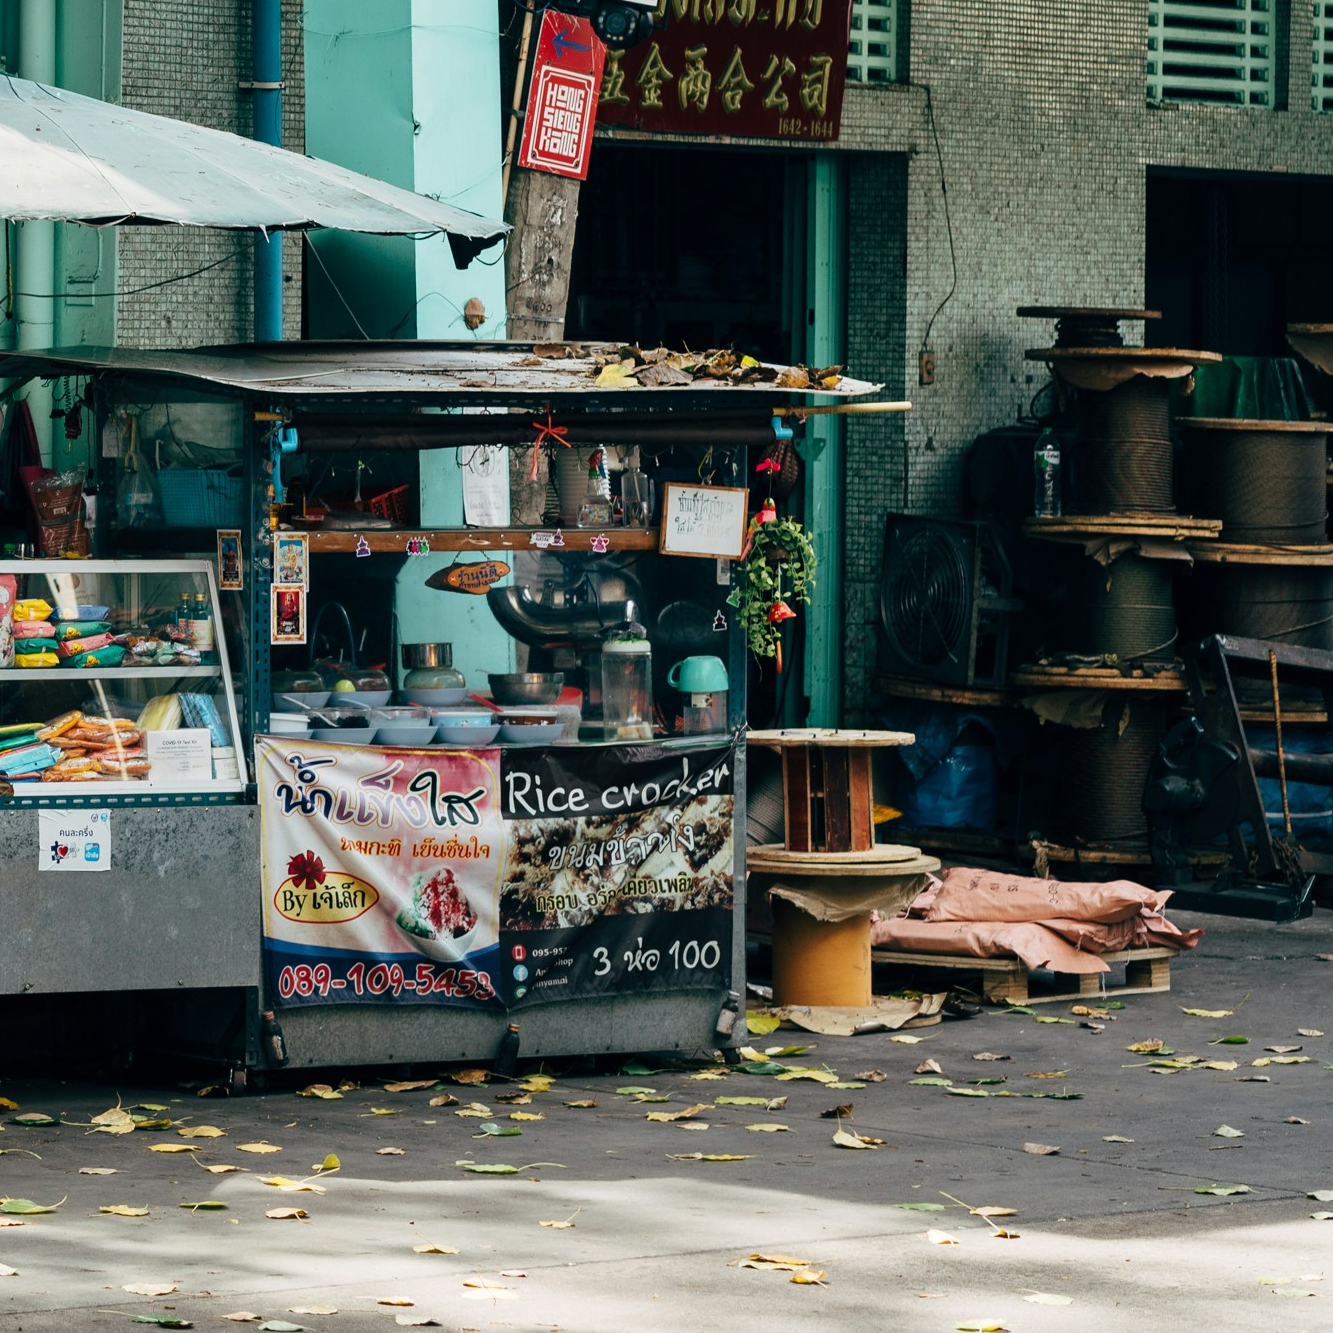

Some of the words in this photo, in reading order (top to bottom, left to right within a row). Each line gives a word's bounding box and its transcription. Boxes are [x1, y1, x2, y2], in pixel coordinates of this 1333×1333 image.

[545, 82, 585, 113] HONG
[542, 106, 582, 134] SIENG
[275, 754, 486, 828] น้ำแข็งใส
[505, 770, 590, 816] Rice
[601, 756, 730, 810] cracker
[59, 825, 94, 837] คนละครึ่ง
[412, 834, 490, 859] เย็นชื่นใจ
[283, 888, 307, 917] By
[313, 882, 366, 909] เจ้เล็ก
[593, 946, 612, 976] 3
[623, 937, 661, 972] ห่อ
[669, 940, 721, 971] 100
[278, 963, 496, 1000] 089-109-5453
